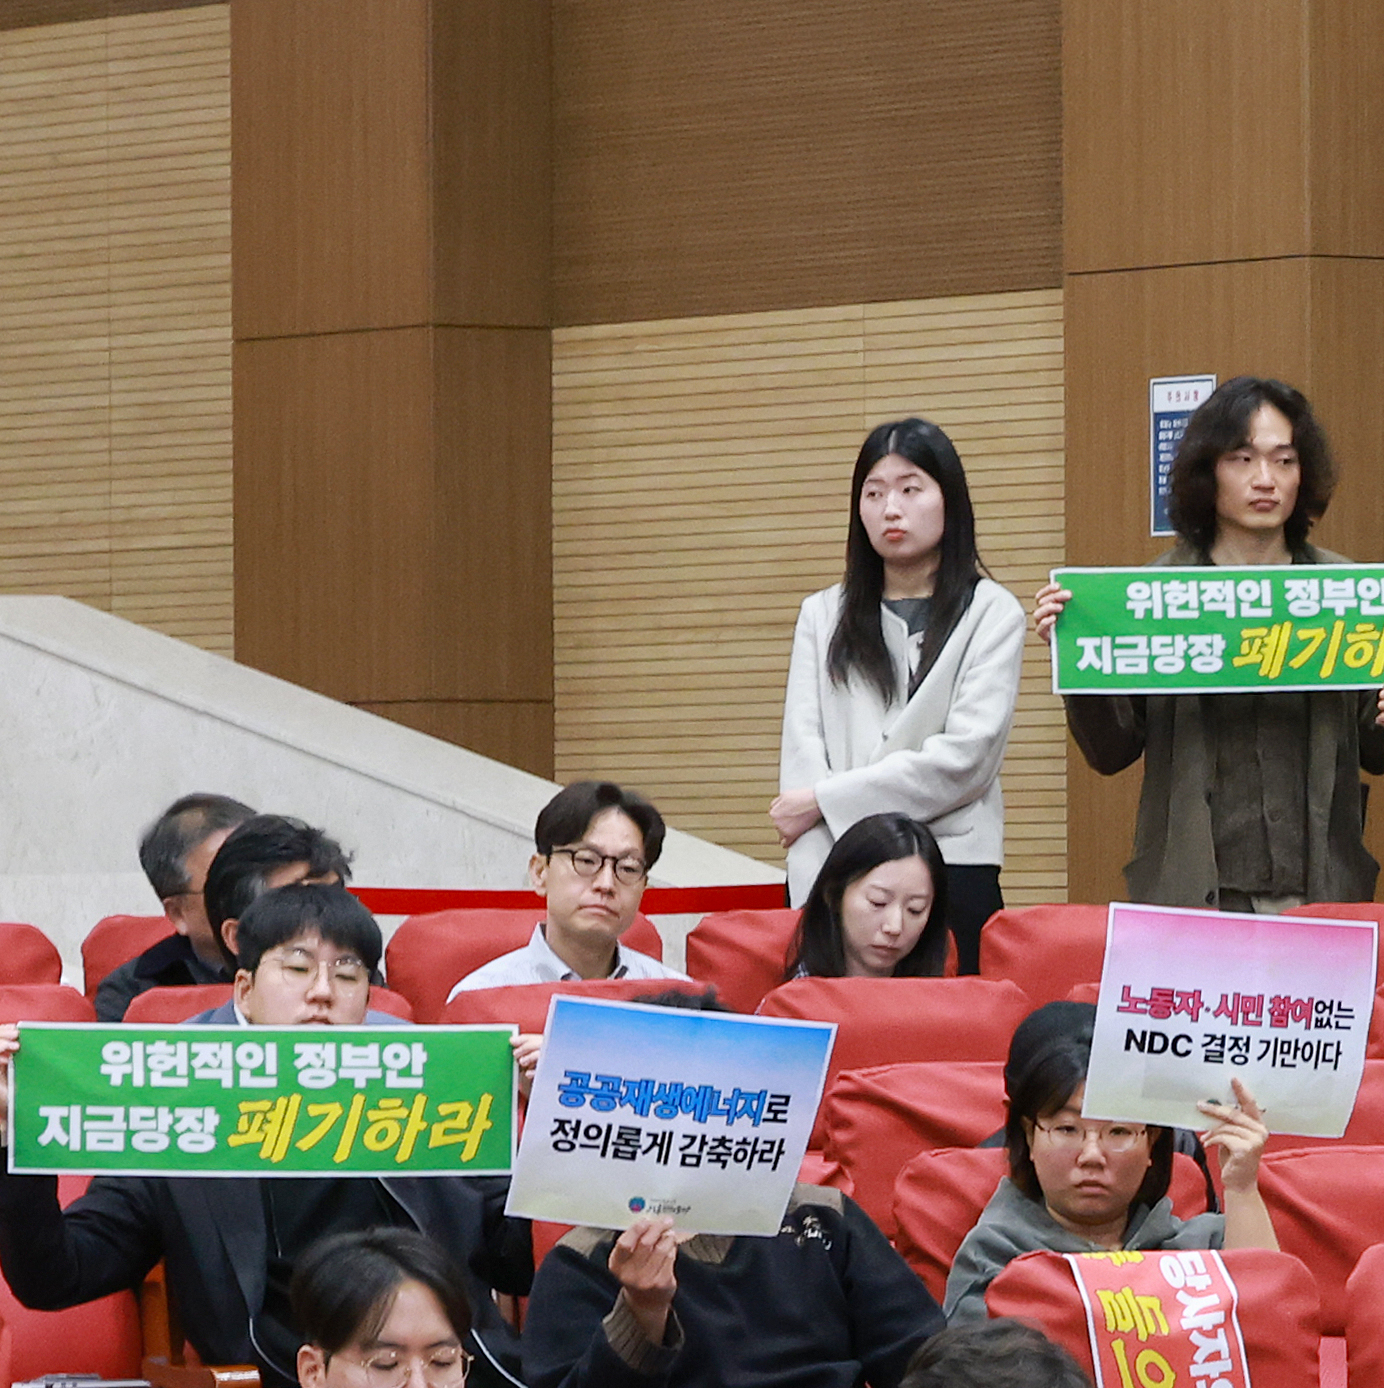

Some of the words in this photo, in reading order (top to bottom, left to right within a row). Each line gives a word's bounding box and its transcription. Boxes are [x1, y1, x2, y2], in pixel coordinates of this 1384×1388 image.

[1126, 580, 1273, 619] 위헌적인
[1076, 634, 1226, 675] 지금당장
[1117, 985, 1264, 1026] 노동자·시민
[100, 1041, 279, 1089] 위헌적인
[293, 1042, 427, 1089] 정부안
[1124, 1028, 1193, 1058] NDC
[1200, 1033, 1251, 1066] 결정
[1256, 1037, 1342, 1070] 기만이다
[558, 1070, 791, 1128] 공공재생에너지로
[37, 1105, 219, 1152] 지금당장
[227, 1093, 493, 1164] 폐기하라
[550, 1118, 674, 1165] 정의롭게
[678, 1134, 785, 1171] 감축하라
